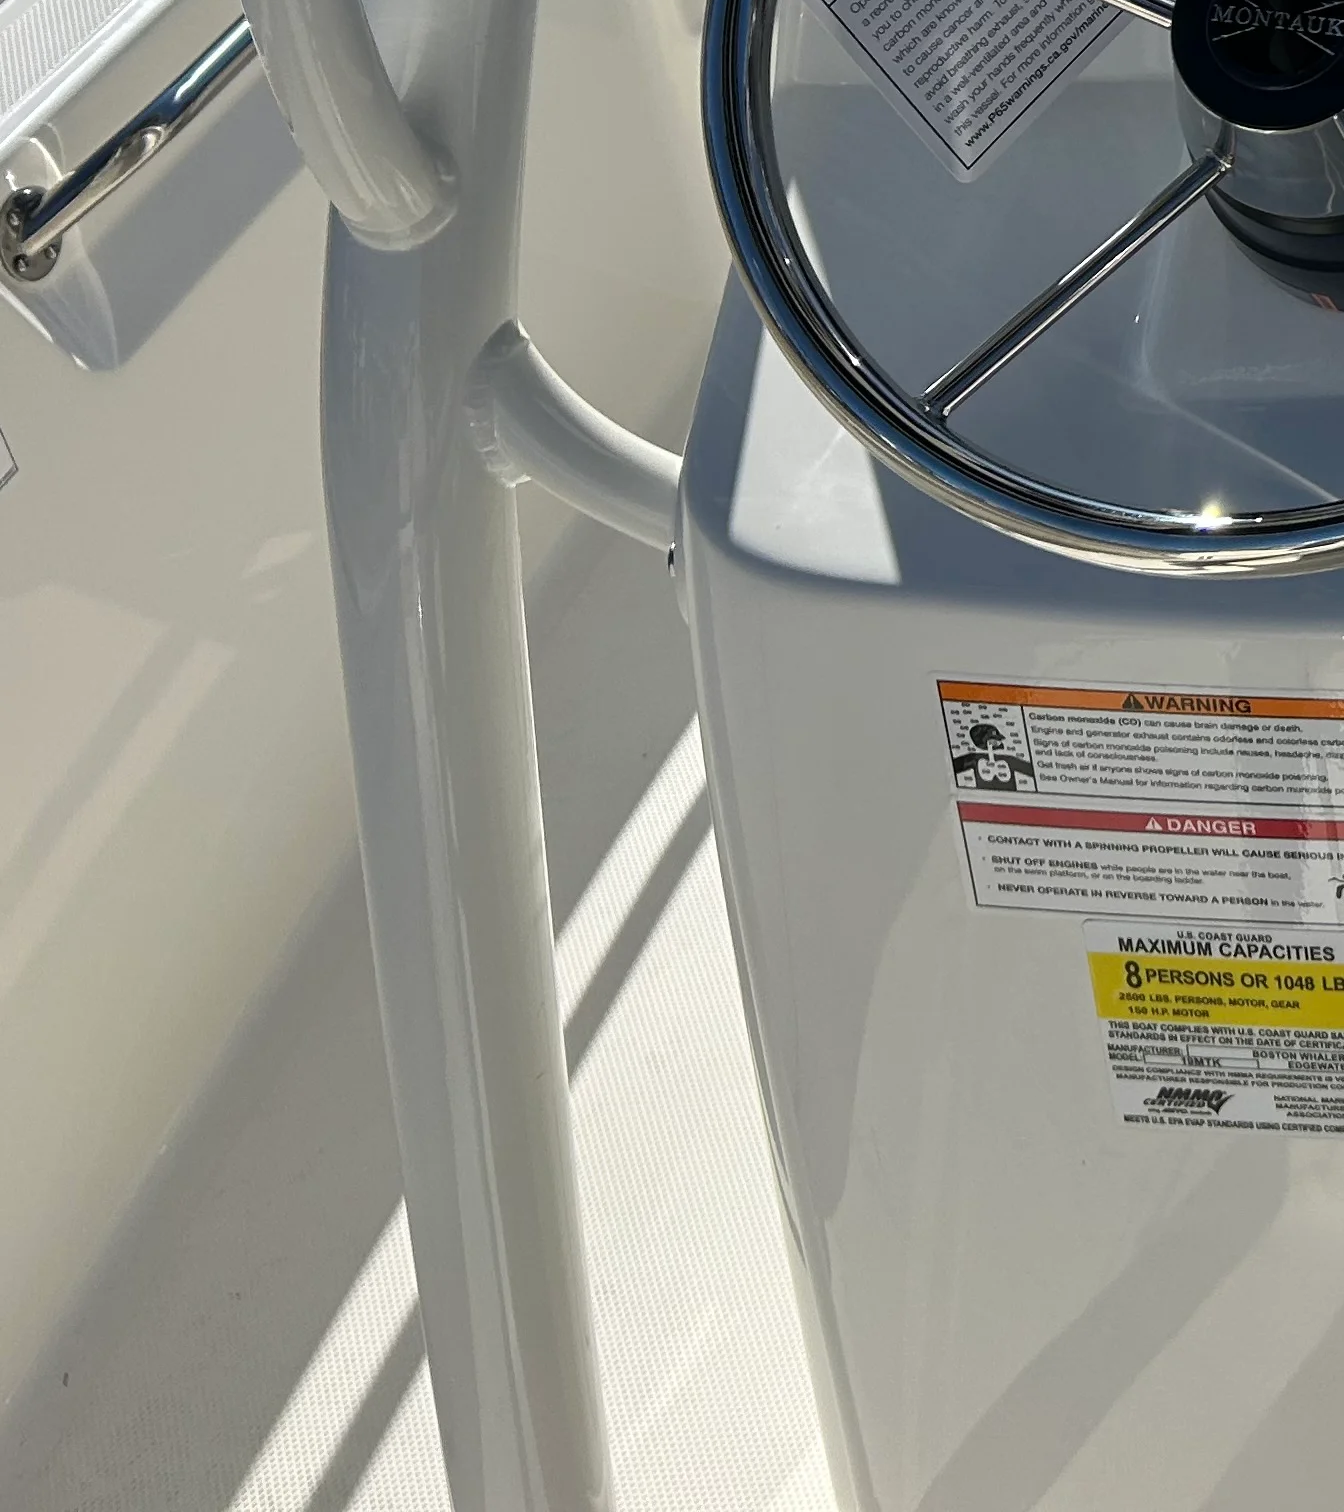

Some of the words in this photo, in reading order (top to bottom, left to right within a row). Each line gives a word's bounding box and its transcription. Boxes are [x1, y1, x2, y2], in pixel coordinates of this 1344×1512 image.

[1030, 0, 1047, 18] and
[872, 21, 891, 41] you
[890, 11, 902, 22] to
[883, 19, 916, 52] carbon
[892, 36, 922, 64] which
[921, 21, 937, 38] are
[903, 65, 915, 76] to
[915, 38, 944, 65] cause
[925, 74, 949, 101] avoid
[947, 37, 989, 77] breathing
[944, 100, 970, 124] wash
[988, 52, 1016, 81] hands
[1145, 696, 1251, 713] WARNING
[1167, 817, 1256, 836] DANGER
[988, 835, 1039, 846] CONTACT
[1043, 839, 1071, 848] WITH
[1142, 845, 1209, 856] PROPELLER
[1212, 848, 1239, 857] WILL
[1242, 850, 1281, 858] CAUSE
[1118, 936, 1212, 956] MAXIMUM
[1220, 943, 1335, 961] CAPACITIES
[1198, 932, 1232, 941] COAST
[1236, 933, 1272, 943] GUARD
[1125, 960, 1142, 988] 8
[1145, 968, 1235, 987] PERSONS
[1241, 973, 1269, 989] OR
[1274, 975, 1315, 990] 1048
[1271, 1000, 1300, 1009] GEAR
[1253, 1050, 1296, 1060] BOSTON
